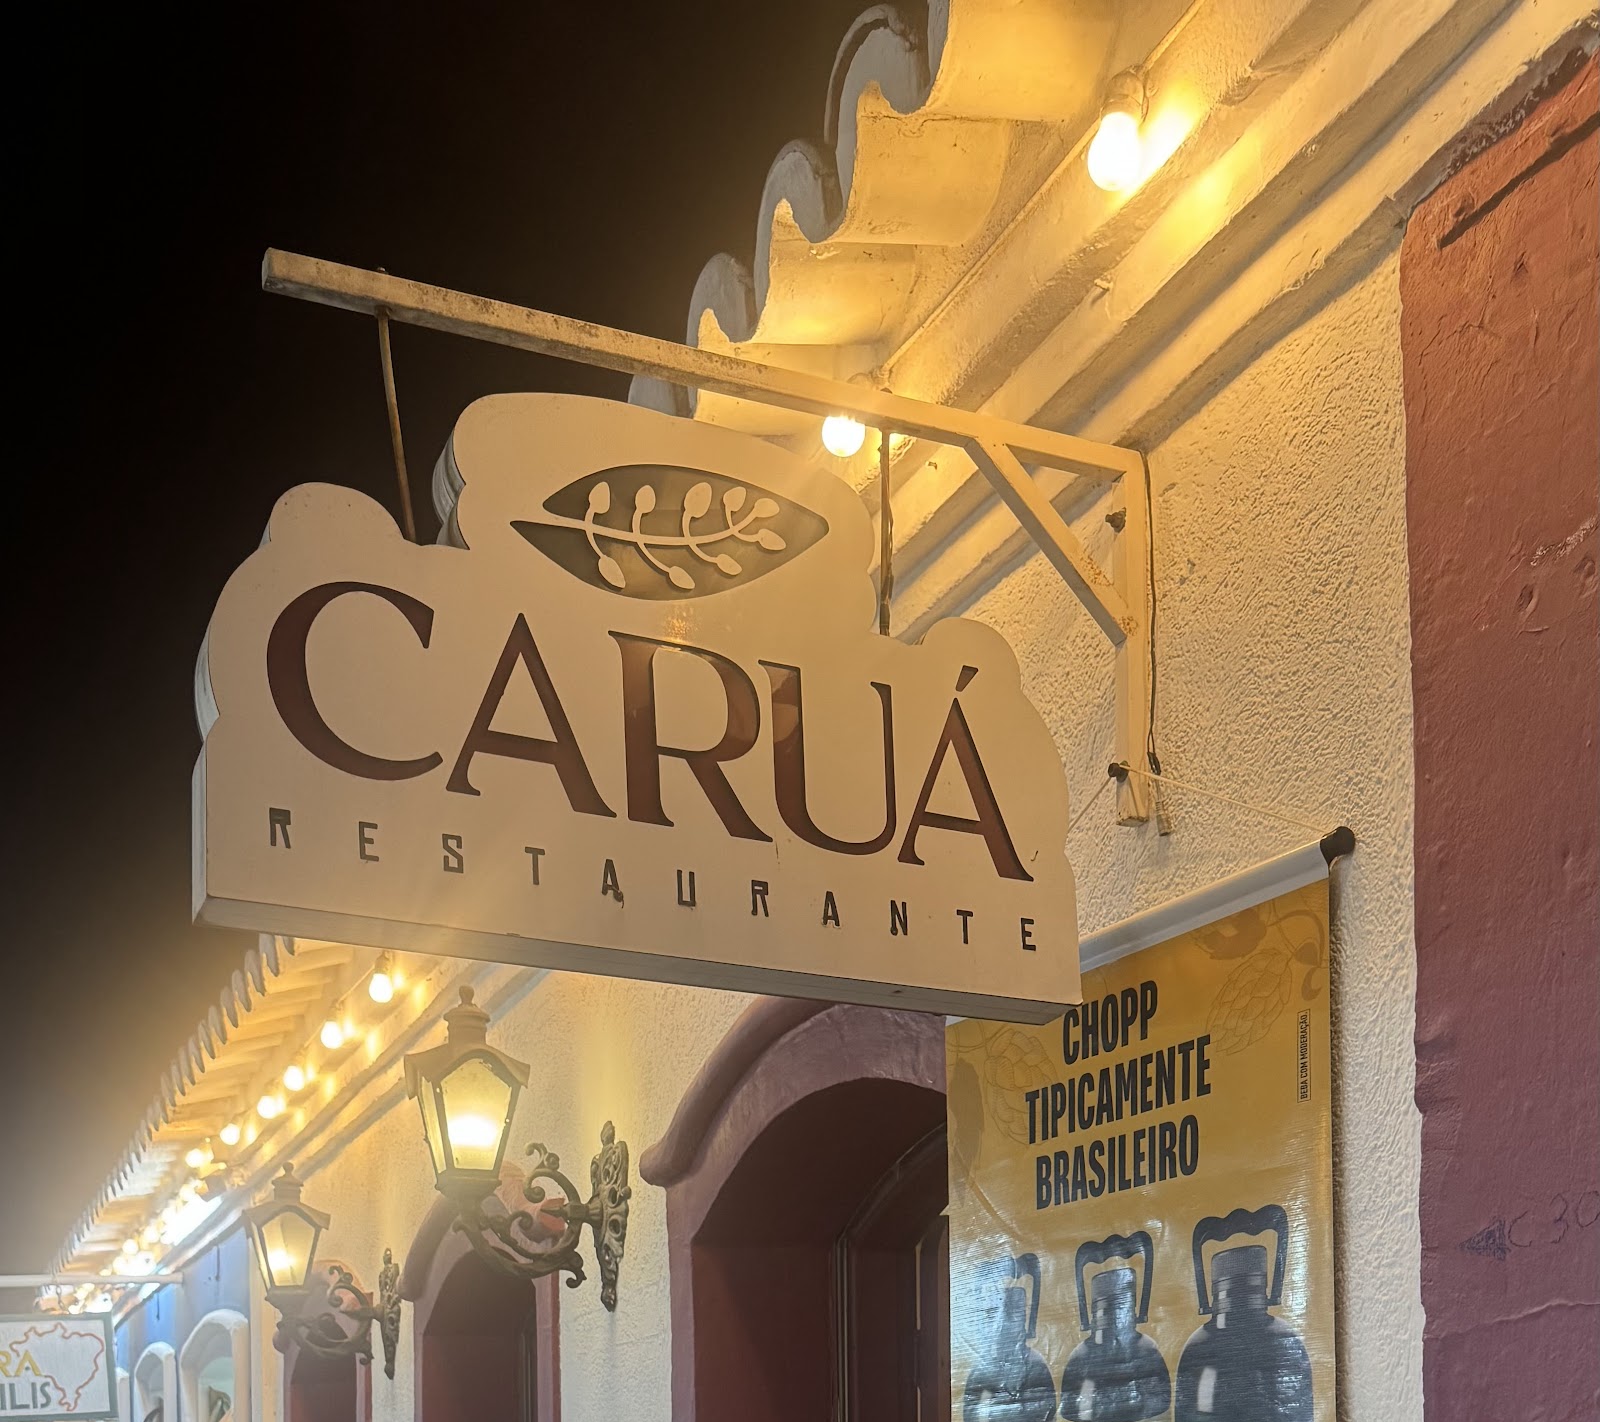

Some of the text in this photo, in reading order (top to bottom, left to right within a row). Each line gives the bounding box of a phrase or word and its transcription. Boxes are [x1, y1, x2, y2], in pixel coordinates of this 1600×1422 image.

[267, 581, 1034, 881] CARUÁ
[269, 807, 1037, 951] RESTAURANTE
[1062, 980, 1158, 1065] CHOPP
[1300, 1061, 1309, 1078] COM
[1025, 1034, 1211, 1144] TIPICAMENTE
[1300, 1080, 1309, 1100] BEBA
[1036, 1115, 1198, 1210] BRASILEIRO
